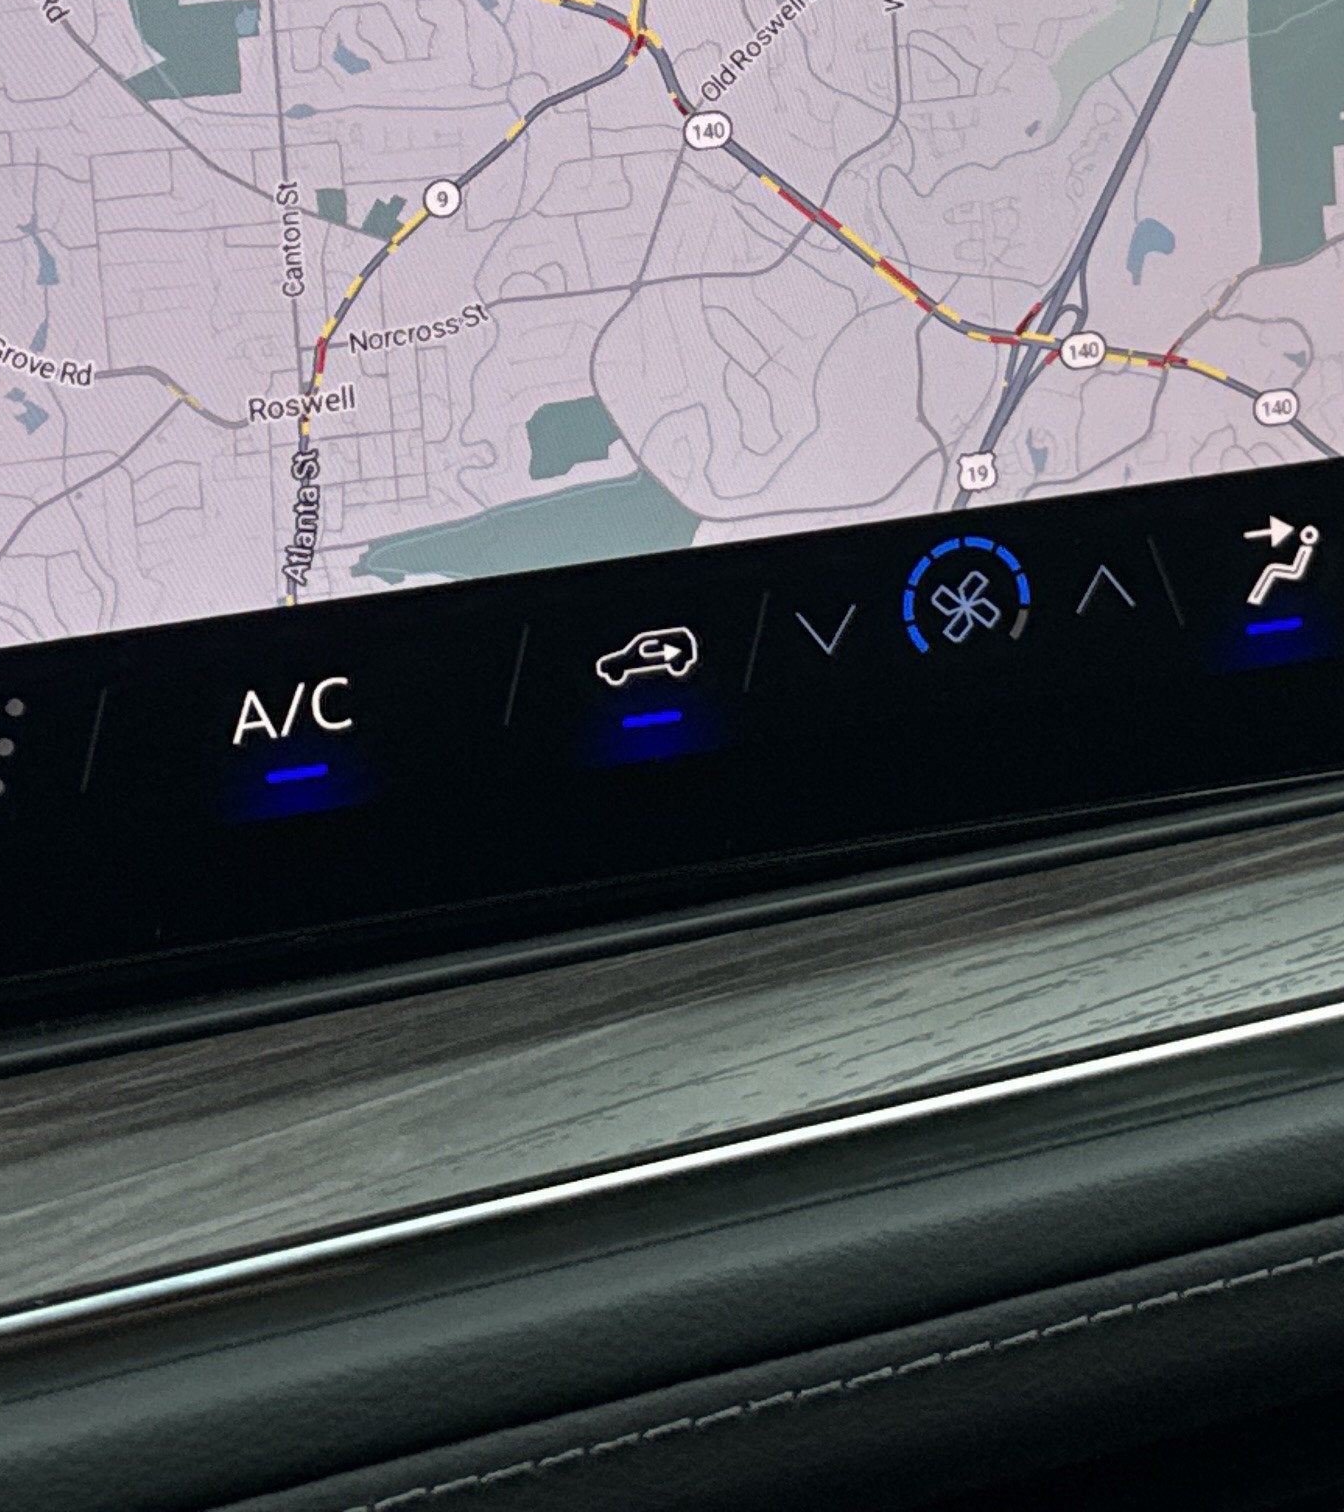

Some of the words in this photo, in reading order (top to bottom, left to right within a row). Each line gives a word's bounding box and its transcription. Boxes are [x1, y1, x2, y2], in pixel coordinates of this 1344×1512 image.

[702, 71, 736, 102] Old
[692, 122, 725, 141] 140
[276, 181, 299, 205] St
[436, 190, 448, 208] 9
[281, 211, 305, 297] Canton
[349, 318, 459, 353] Norcross
[462, 305, 488, 329] St
[1069, 342, 1099, 360] 140
[60, 361, 92, 386] Rd
[249, 386, 356, 421] Roswell
[1262, 399, 1292, 417] 140
[290, 448, 320, 480] St
[967, 464, 988, 482] 19
[281, 485, 321, 587] Atlanta
[233, 678, 352, 746] A/C
